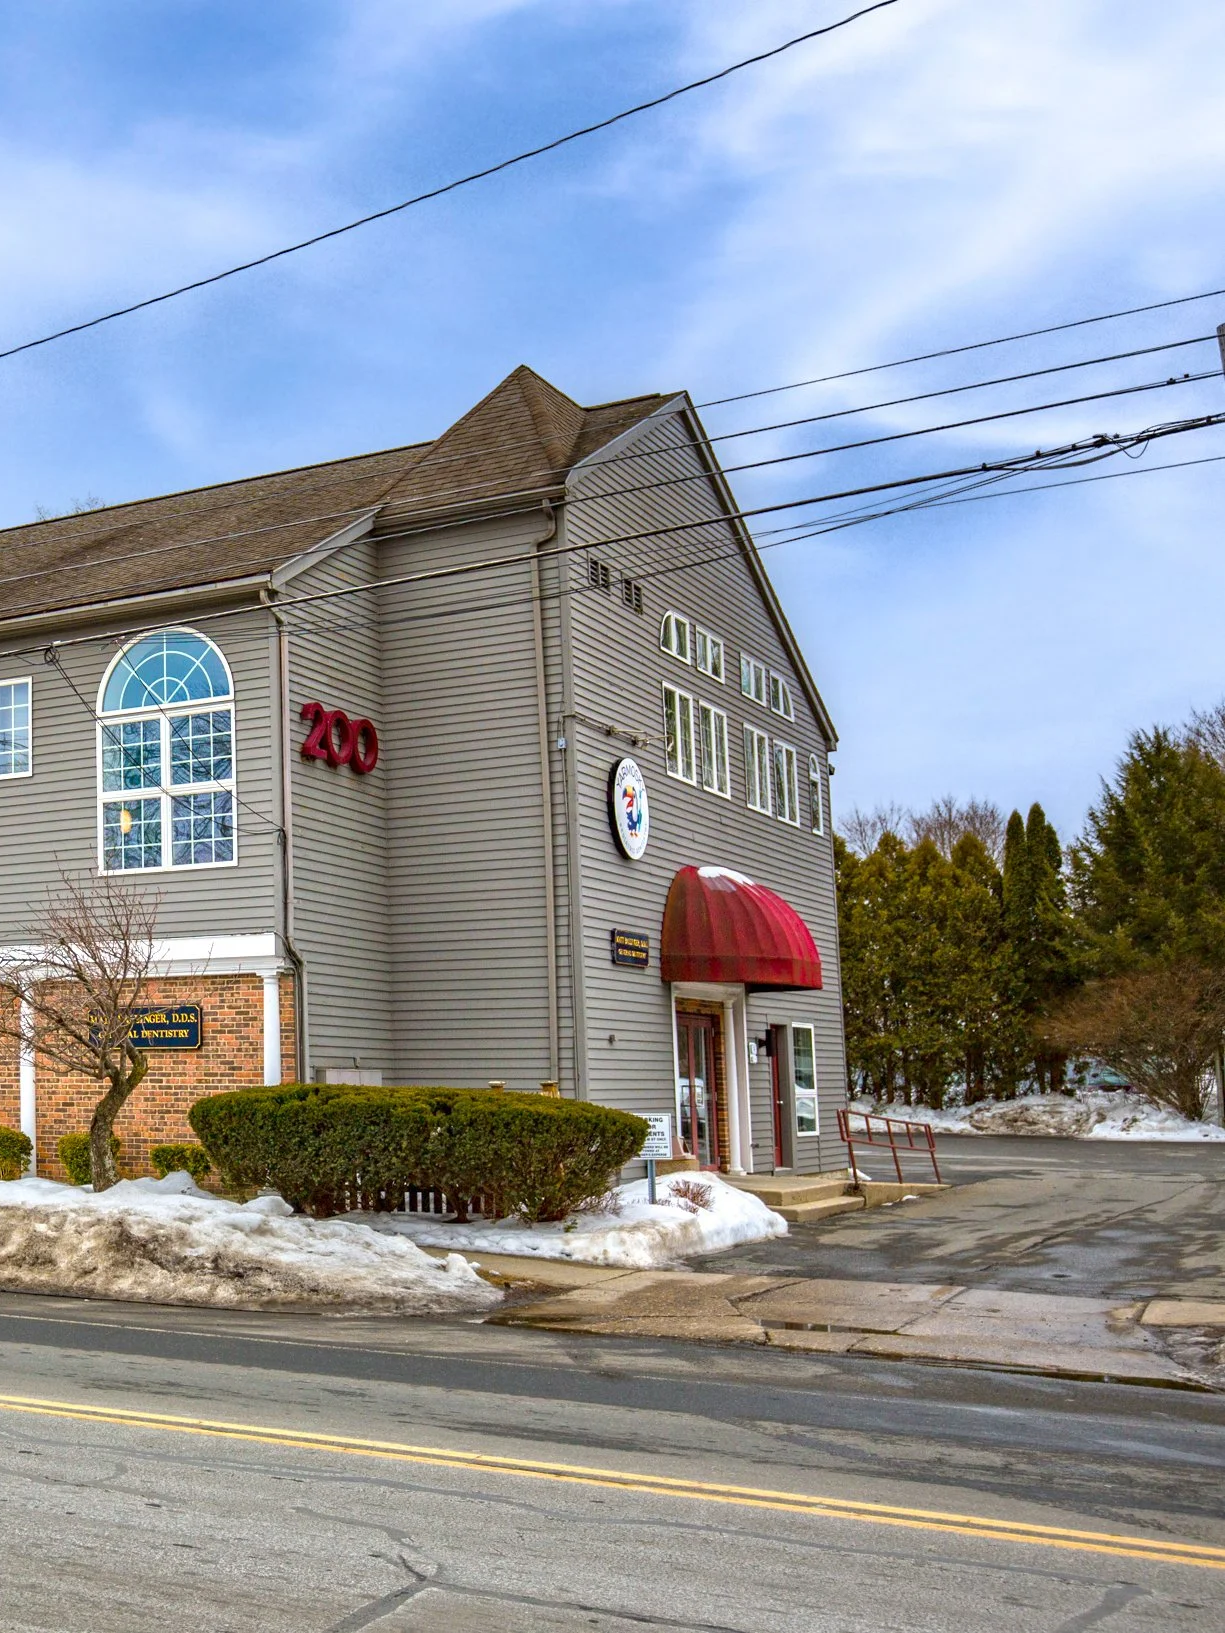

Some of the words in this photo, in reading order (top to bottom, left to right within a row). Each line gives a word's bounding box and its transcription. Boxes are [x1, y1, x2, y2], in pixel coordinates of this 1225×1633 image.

[300, 702, 378, 774] 200
[172, 1013, 197, 1023] D.D.S.
[141, 1029, 190, 1039] DENTISTRY
